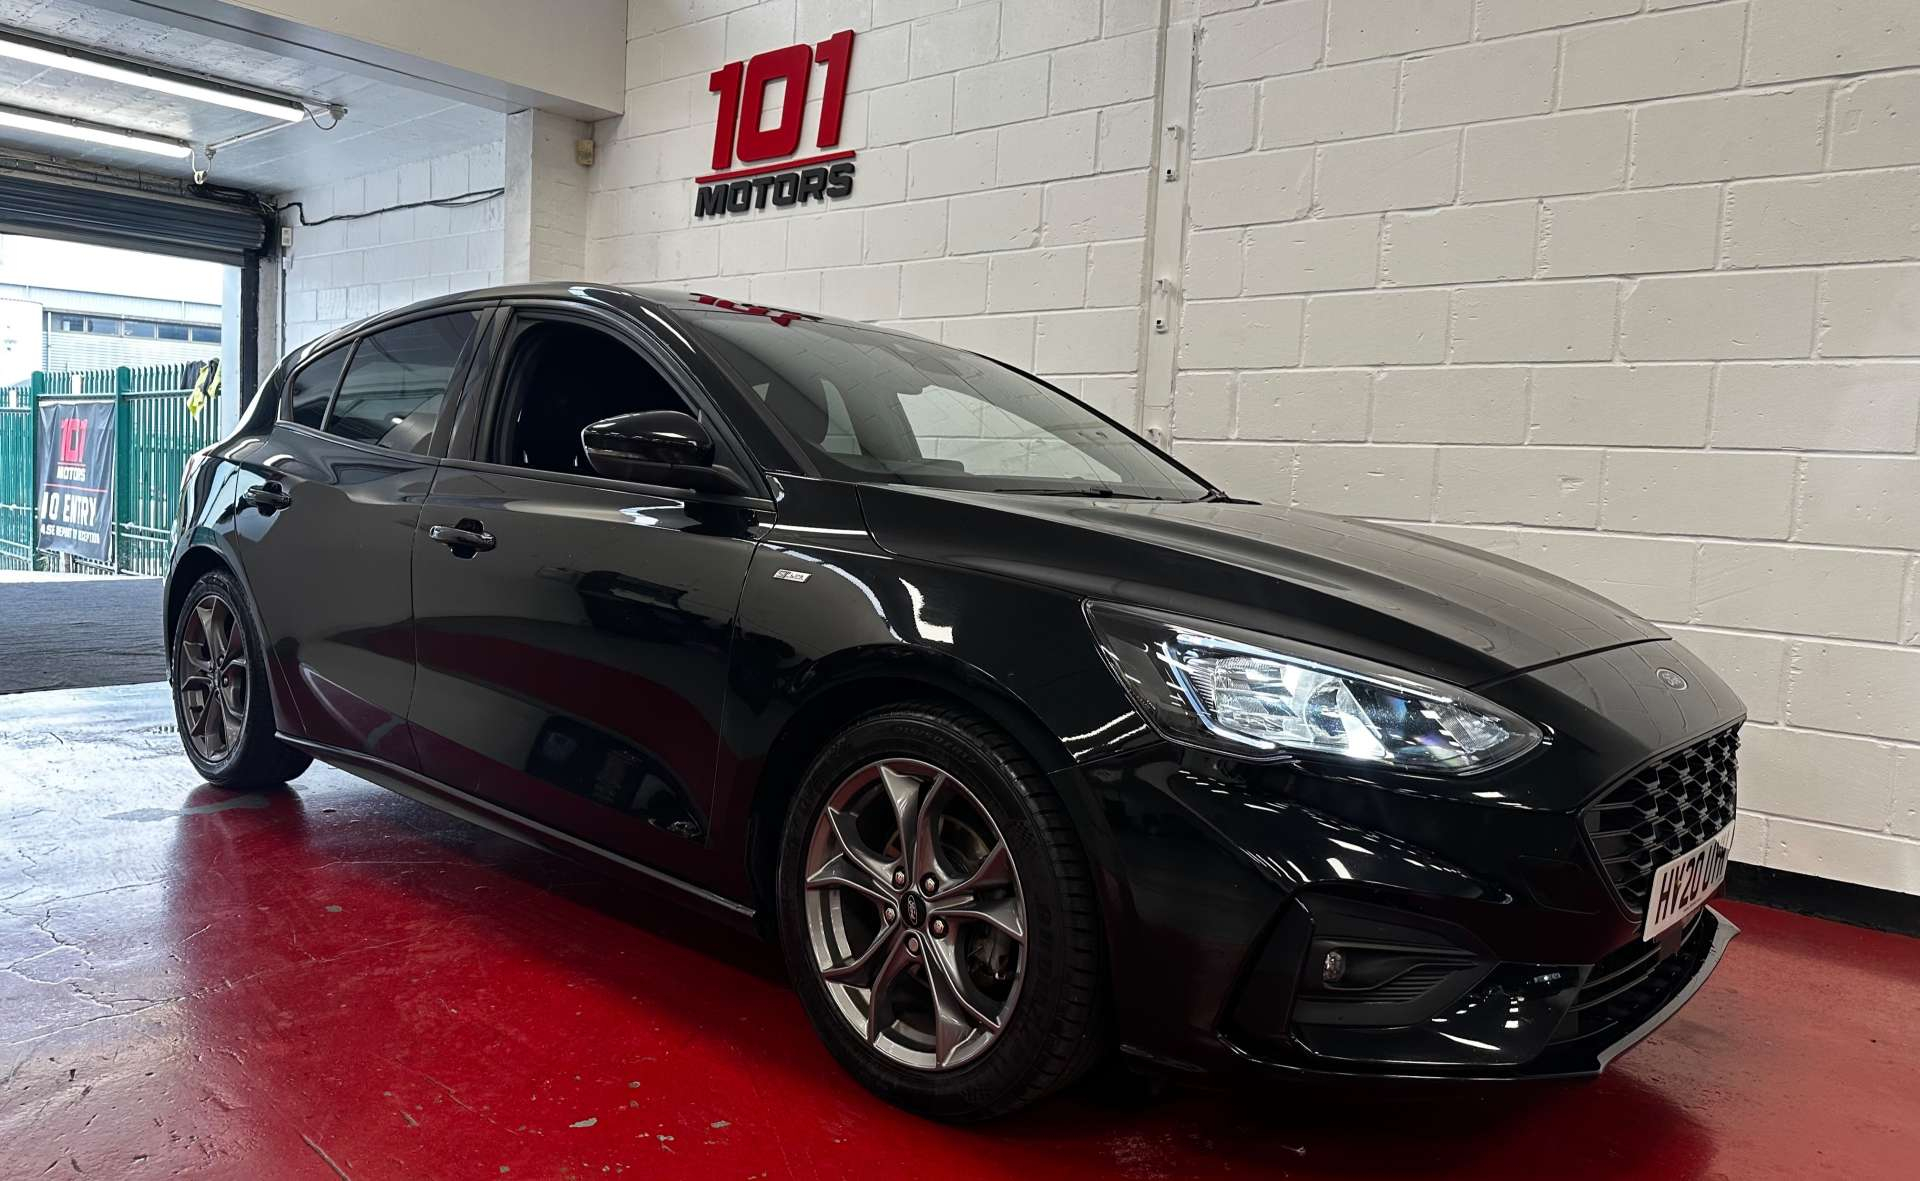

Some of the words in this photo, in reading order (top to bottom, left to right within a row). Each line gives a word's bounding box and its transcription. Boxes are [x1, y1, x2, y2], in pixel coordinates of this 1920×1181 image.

[709, 29, 855, 170] 101
[694, 162, 856, 218] MOTORS
[60, 418, 88, 463] 101
[56, 465, 87, 482] MOTORS
[63, 494, 97, 527] ENTRY
